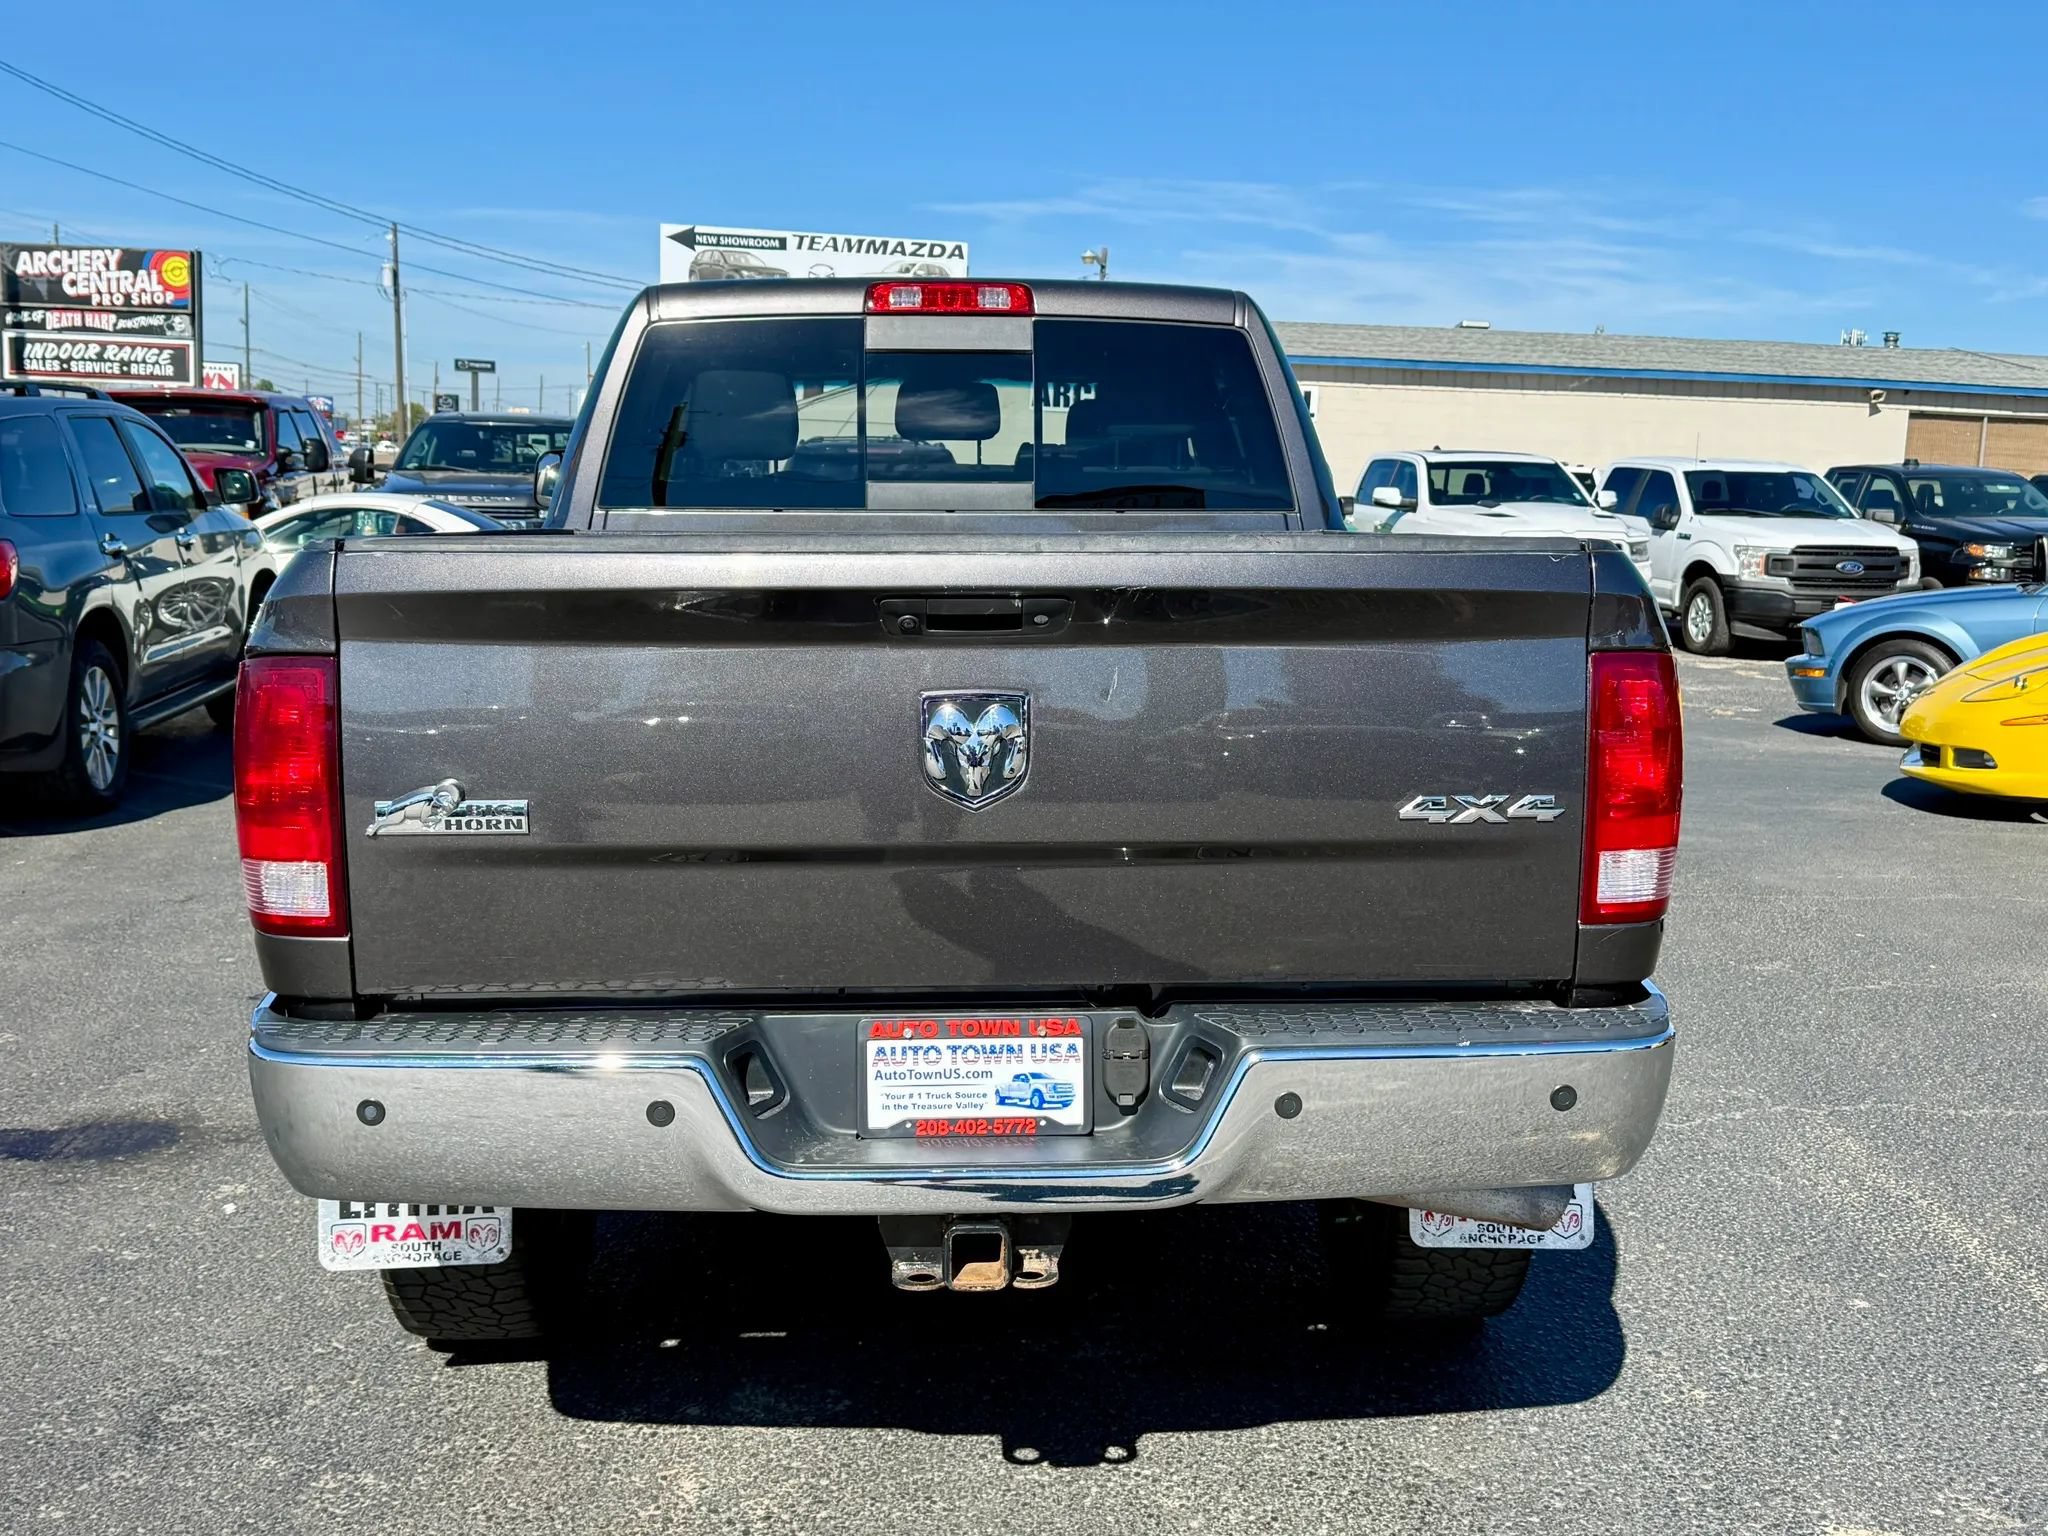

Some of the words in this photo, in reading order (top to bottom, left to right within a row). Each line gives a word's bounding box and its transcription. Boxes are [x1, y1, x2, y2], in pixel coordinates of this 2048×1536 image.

[695, 234, 718, 245] NEW
[719, 235, 780, 248] SHOWROOM
[15, 248, 123, 277] ARCHERY
[61, 268, 164, 297] CENTRAL
[91, 291, 125, 306] PRO
[130, 291, 175, 306] SHOP
[45, 309, 82, 330] DEATH
[83, 310, 117, 332] HARP
[23, 342, 100, 360] INDOOR
[103, 344, 174, 365] RANGE
[23, 359, 61, 371] SALES
[70, 360, 121, 374] SERVICE
[130, 363, 174, 376] REPAIR
[465, 804, 513, 817] BIG
[444, 818, 523, 831] HORN
[869, 1019, 938, 1038] AUTO
[946, 1019, 1020, 1037] TOWN
[1028, 1018, 1081, 1036] USA
[872, 1044, 943, 1067] AUTO
[947, 1044, 1024, 1066] TOWN
[1031, 1043, 1081, 1065] USA
[874, 1068, 993, 1081] AutoTownUS.com
[927, 1091, 952, 1099] Truck
[955, 1091, 988, 1099] Source
[881, 1102, 891, 1110] in
[893, 1102, 909, 1110] the
[911, 1102, 953, 1110] Treasure
[915, 1118, 1036, 1136] 208-402-5772
[370, 1221, 462, 1243] RAM
[390, 1241, 442, 1253] SOUTH
